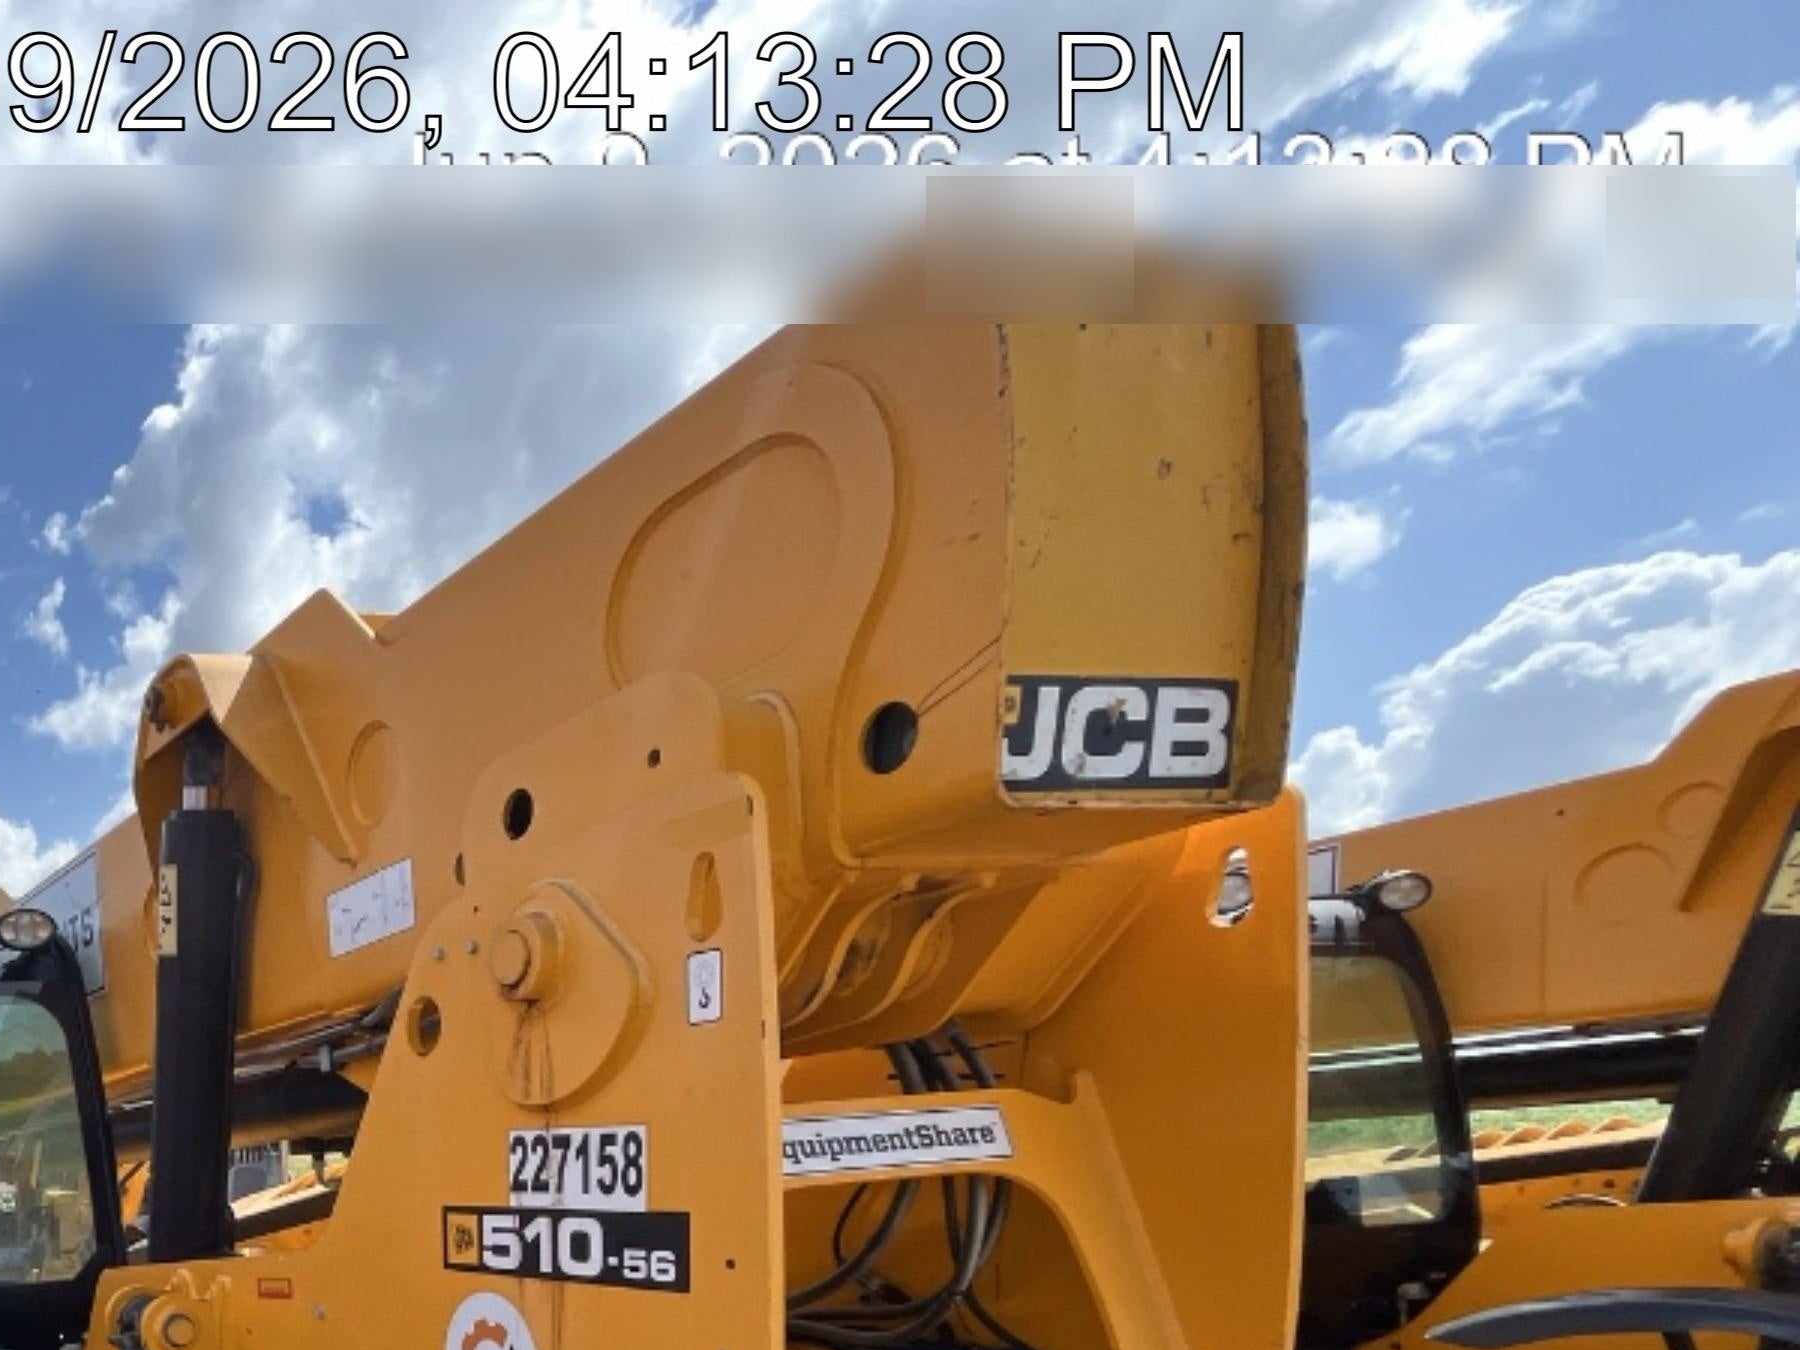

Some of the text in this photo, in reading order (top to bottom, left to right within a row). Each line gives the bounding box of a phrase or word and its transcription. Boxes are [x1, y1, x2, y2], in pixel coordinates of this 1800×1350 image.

[1001, 685, 1231, 780] JCB
[509, 1130, 643, 1198] 227158
[783, 1123, 997, 1164] quipmentShare
[481, 1213, 677, 1283] 510-56
